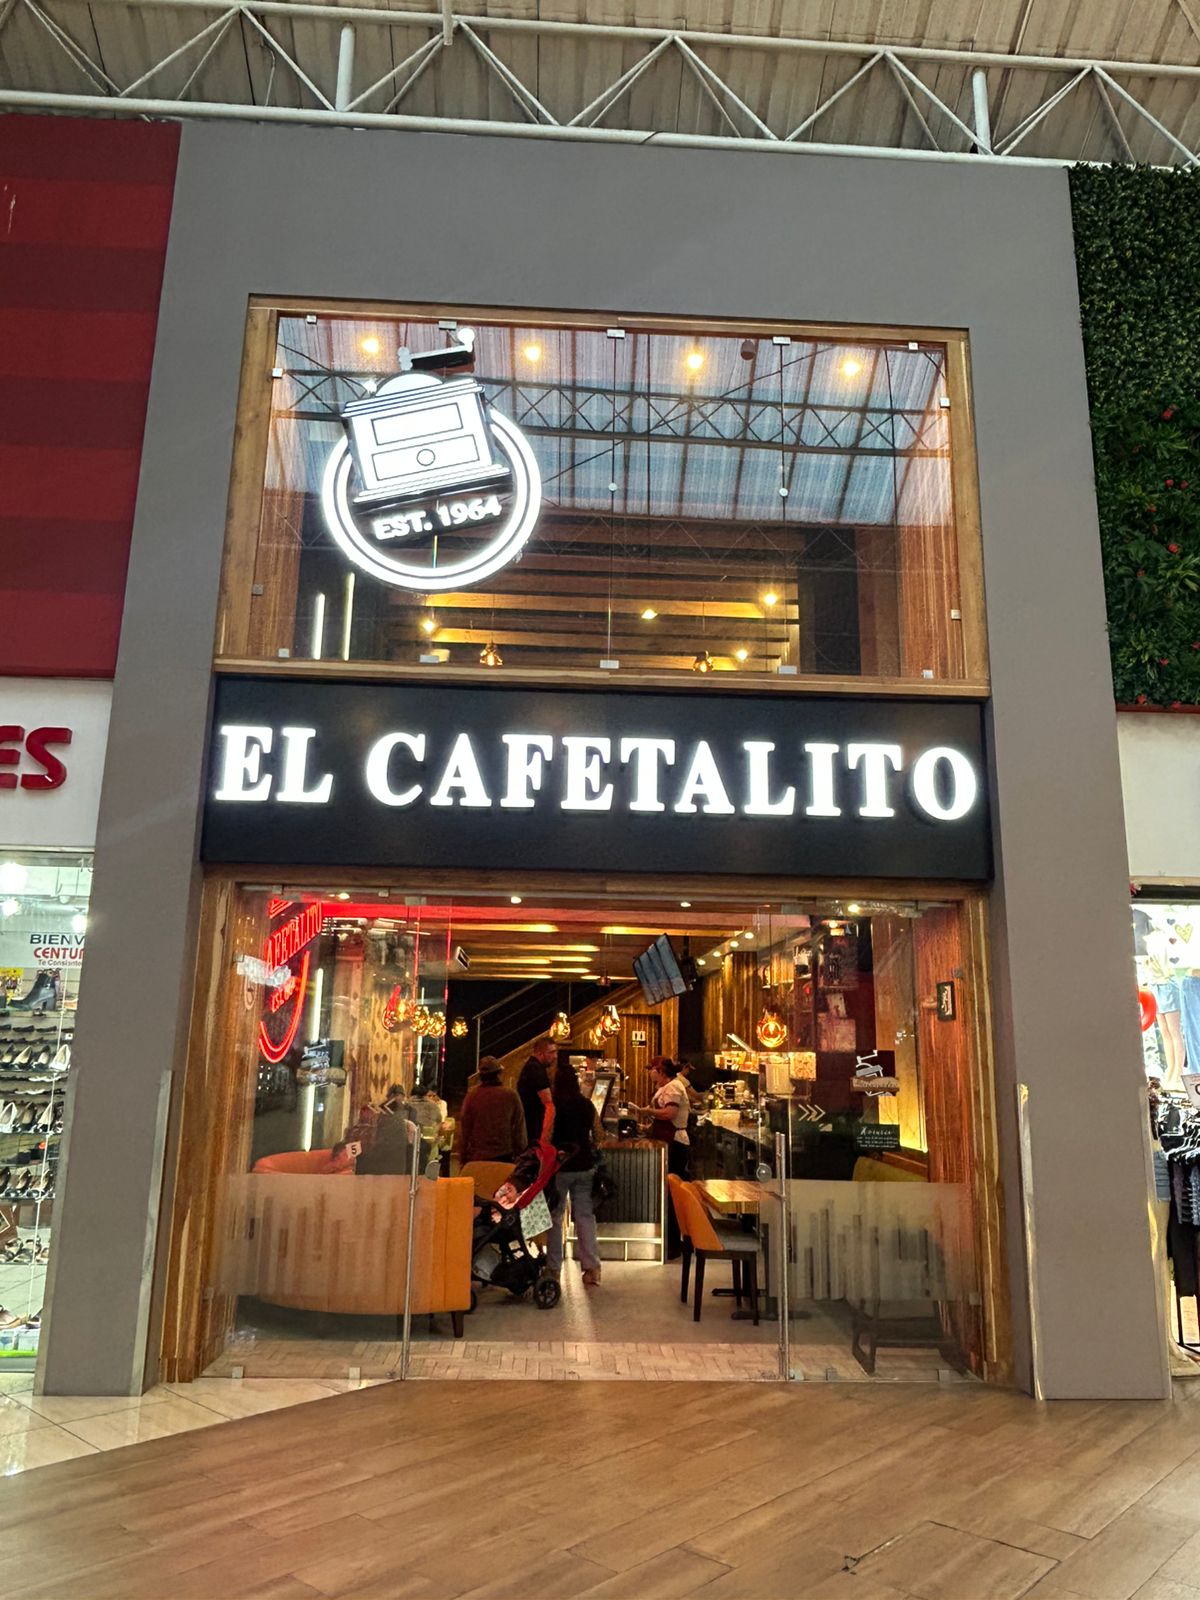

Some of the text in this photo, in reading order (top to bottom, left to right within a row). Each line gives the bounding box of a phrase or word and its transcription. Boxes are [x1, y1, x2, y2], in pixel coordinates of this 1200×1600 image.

[373, 494, 502, 540] EST. 1964
[214, 724, 978, 822] EL CAFETALITO
